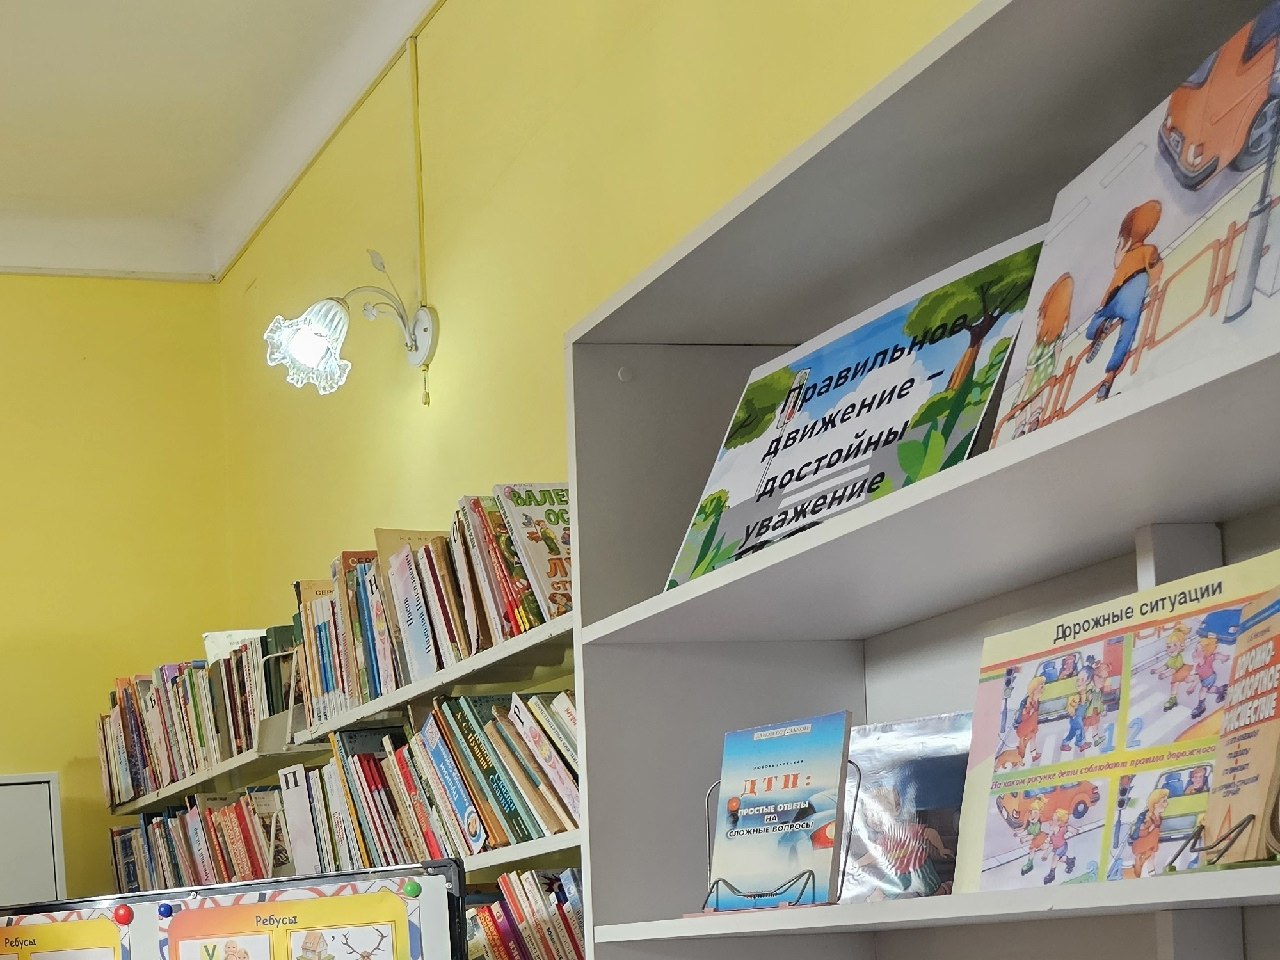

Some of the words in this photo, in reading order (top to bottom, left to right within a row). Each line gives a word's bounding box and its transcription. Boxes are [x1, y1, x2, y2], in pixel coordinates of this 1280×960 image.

[780, 313, 968, 414] Правильное
[760, 377, 915, 463] движение
[756, 419, 910, 502] достойны
[738, 471, 886, 551] уважение
[404, 597, 414, 628] Носов
[1053, 606, 1134, 644] Дорожные
[1139, 581, 1223, 617] ситуации
[418, 610, 432, 654] Николай
[467, 733, 488, 770] Пушкин
[1027, 772, 1056, 787] рисунке
[1057, 768, 1078, 779] дети
[1079, 761, 1127, 775] соблюдают
[1128, 754, 1165, 768] правила
[1166, 745, 1216, 760] дорожного
[283, 771, 299, 790] П
[440, 762, 459, 801] Пушкин
[738, 804, 775, 816] ПРОСТЫЕ
[777, 800, 809, 811] ОТВЕТЫ
[764, 815, 778, 823] НА
[728, 827, 770, 838] СЛОЖНЫЕ
[255, 913, 299, 927] Ребусы
[4, 936, 37, 950] Ребусы
